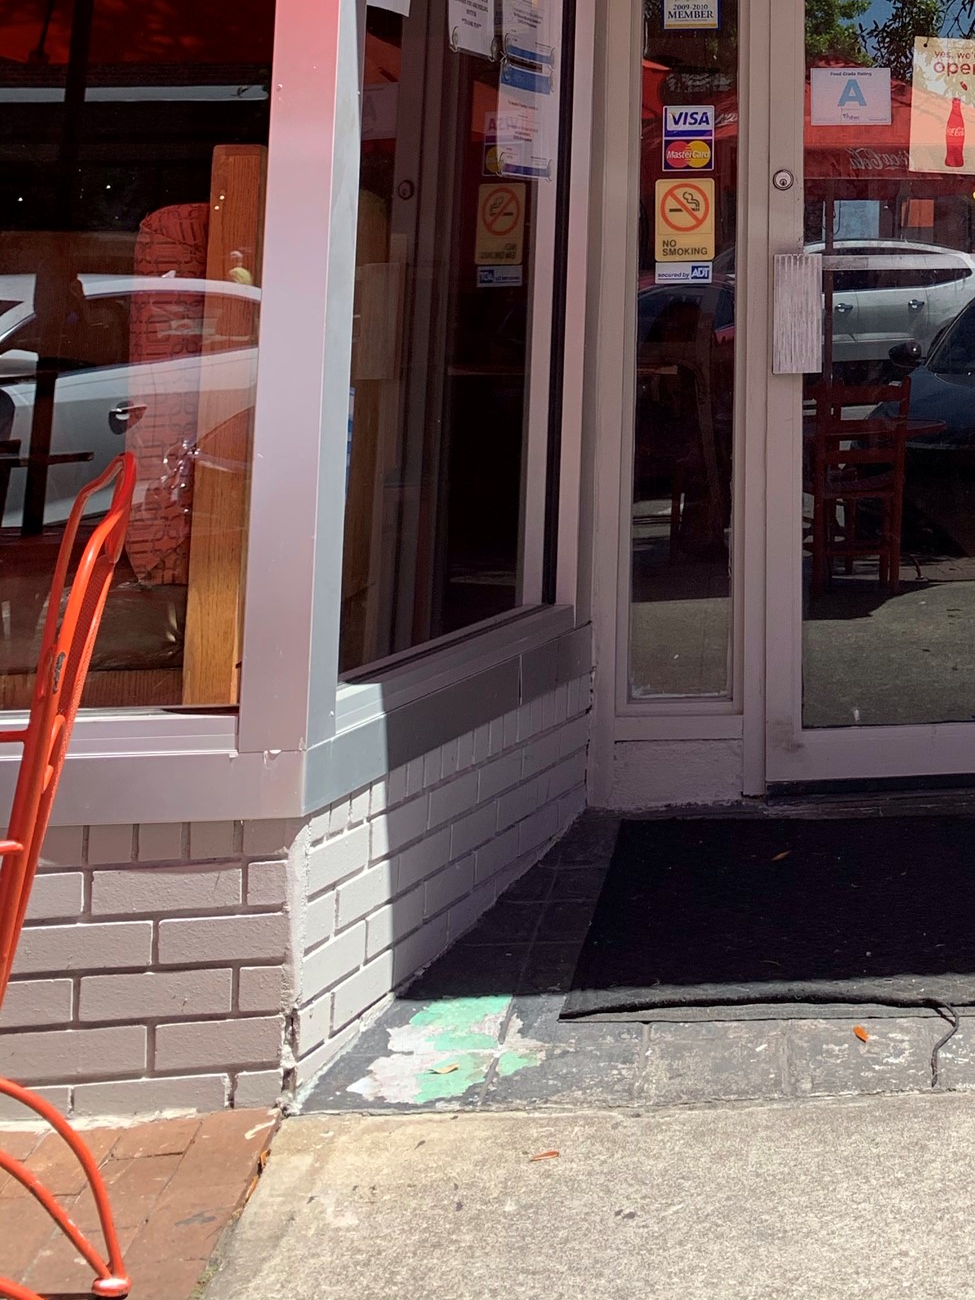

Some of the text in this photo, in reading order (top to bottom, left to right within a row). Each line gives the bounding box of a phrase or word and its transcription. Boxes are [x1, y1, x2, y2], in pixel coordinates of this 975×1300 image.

[668, 10, 714, 19] MEMBER
[837, 79, 867, 106] A
[670, 112, 710, 125] VISA
[667, 150, 709, 159] MasterCard
[662, 247, 708, 256] SMOKING
[691, 268, 710, 278] ADT
